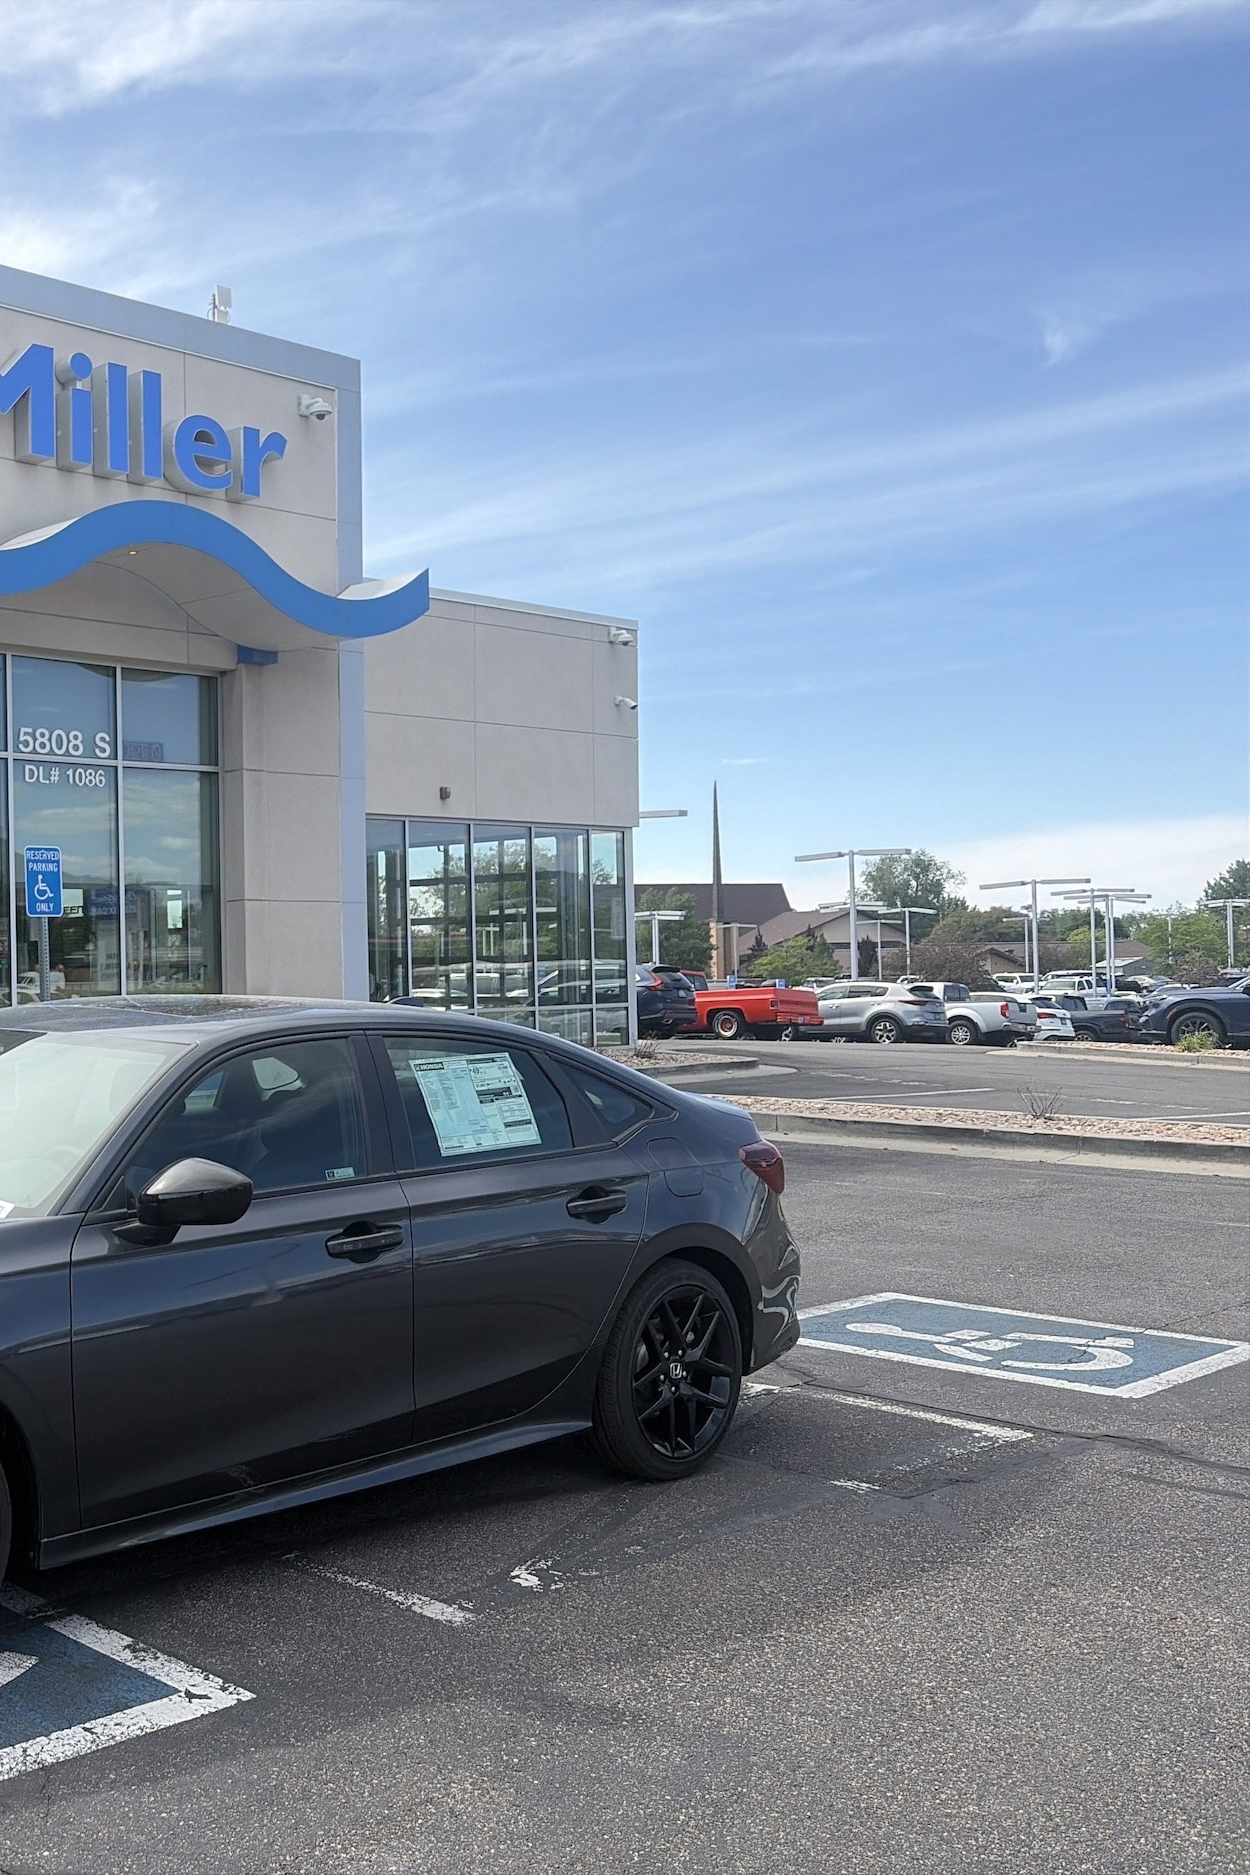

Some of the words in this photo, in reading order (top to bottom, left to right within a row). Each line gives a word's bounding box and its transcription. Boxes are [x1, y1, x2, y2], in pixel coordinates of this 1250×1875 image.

[18, 727, 84, 756] 5808
[94, 732, 111, 758] S
[24, 764, 60, 784] DL#
[66, 768, 106, 787] 1086
[26, 850, 60, 860] RESERVED
[28, 862, 58, 872] PARKING
[36, 903, 54, 912] ONLY
